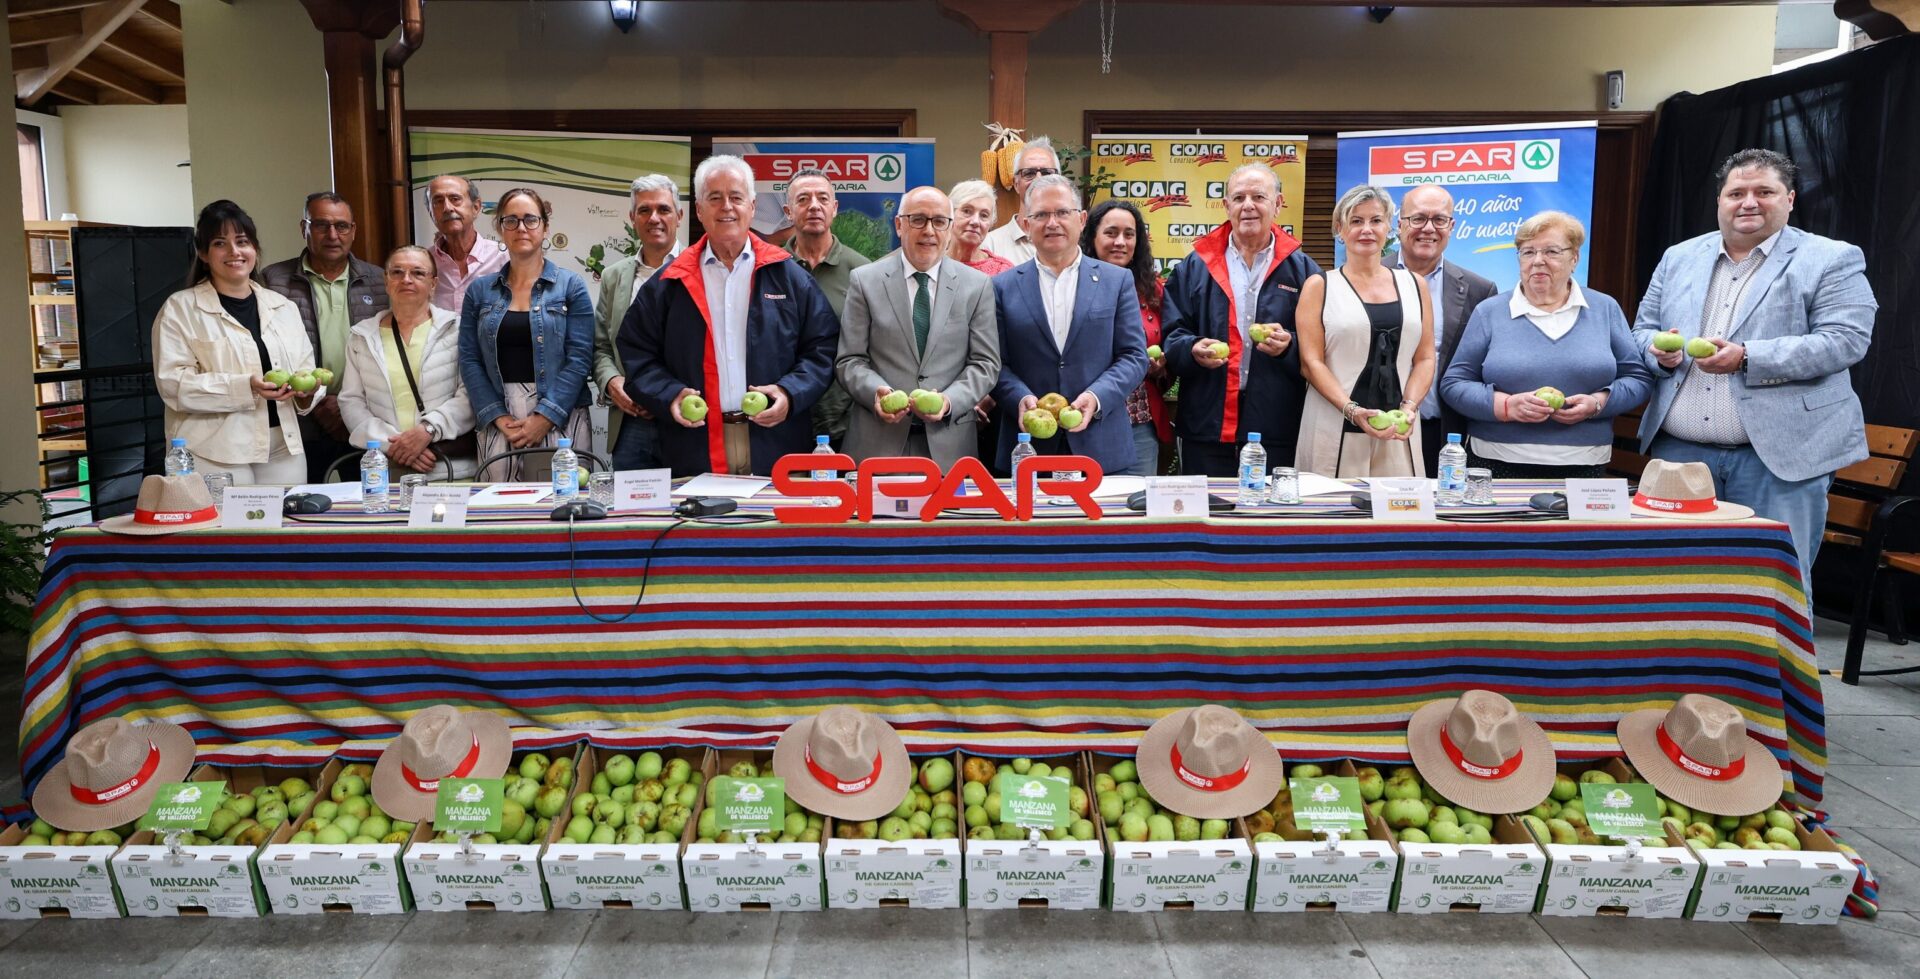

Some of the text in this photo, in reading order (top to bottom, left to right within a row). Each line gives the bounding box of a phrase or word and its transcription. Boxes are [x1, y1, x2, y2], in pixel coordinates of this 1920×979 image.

[1098, 144, 1152, 156] COAG
[1172, 144, 1224, 156] COAG
[1244, 145, 1296, 156] COAG
[1403, 148, 1512, 170] SPAR
[772, 160, 867, 176] SPAR
[1403, 173, 1512, 185] GRAN CANARIA
[1112, 182, 1186, 198] COAG
[1454, 194, 1522, 216] 40 años
[1456, 218, 1524, 240] lo nuest
[771, 453, 1104, 524] SPAR
[1686, 760, 1711, 774] SPAR
[156, 806, 202, 816] MANZANA
[445, 806, 491, 816] MANZANA
[725, 806, 773, 815] MANZANA
[1009, 800, 1056, 812] MANZANA
[435, 875, 504, 884] MANZANA
[576, 876, 644, 884] MANZANA
[855, 872, 924, 881] MANZANA
[996, 871, 1066, 880] MANZANA
[1146, 874, 1216, 884] MANZANA
[1289, 874, 1358, 883] MANZANA
[1432, 875, 1503, 884] MANZANA
[11, 878, 80, 888] MANZANA
[150, 877, 219, 887] MANZANA
[290, 876, 360, 886] MANZANA
[716, 877, 785, 886] MANZANA
[1579, 878, 1653, 888] MANZANA
[1735, 885, 1810, 896] MANZANA
